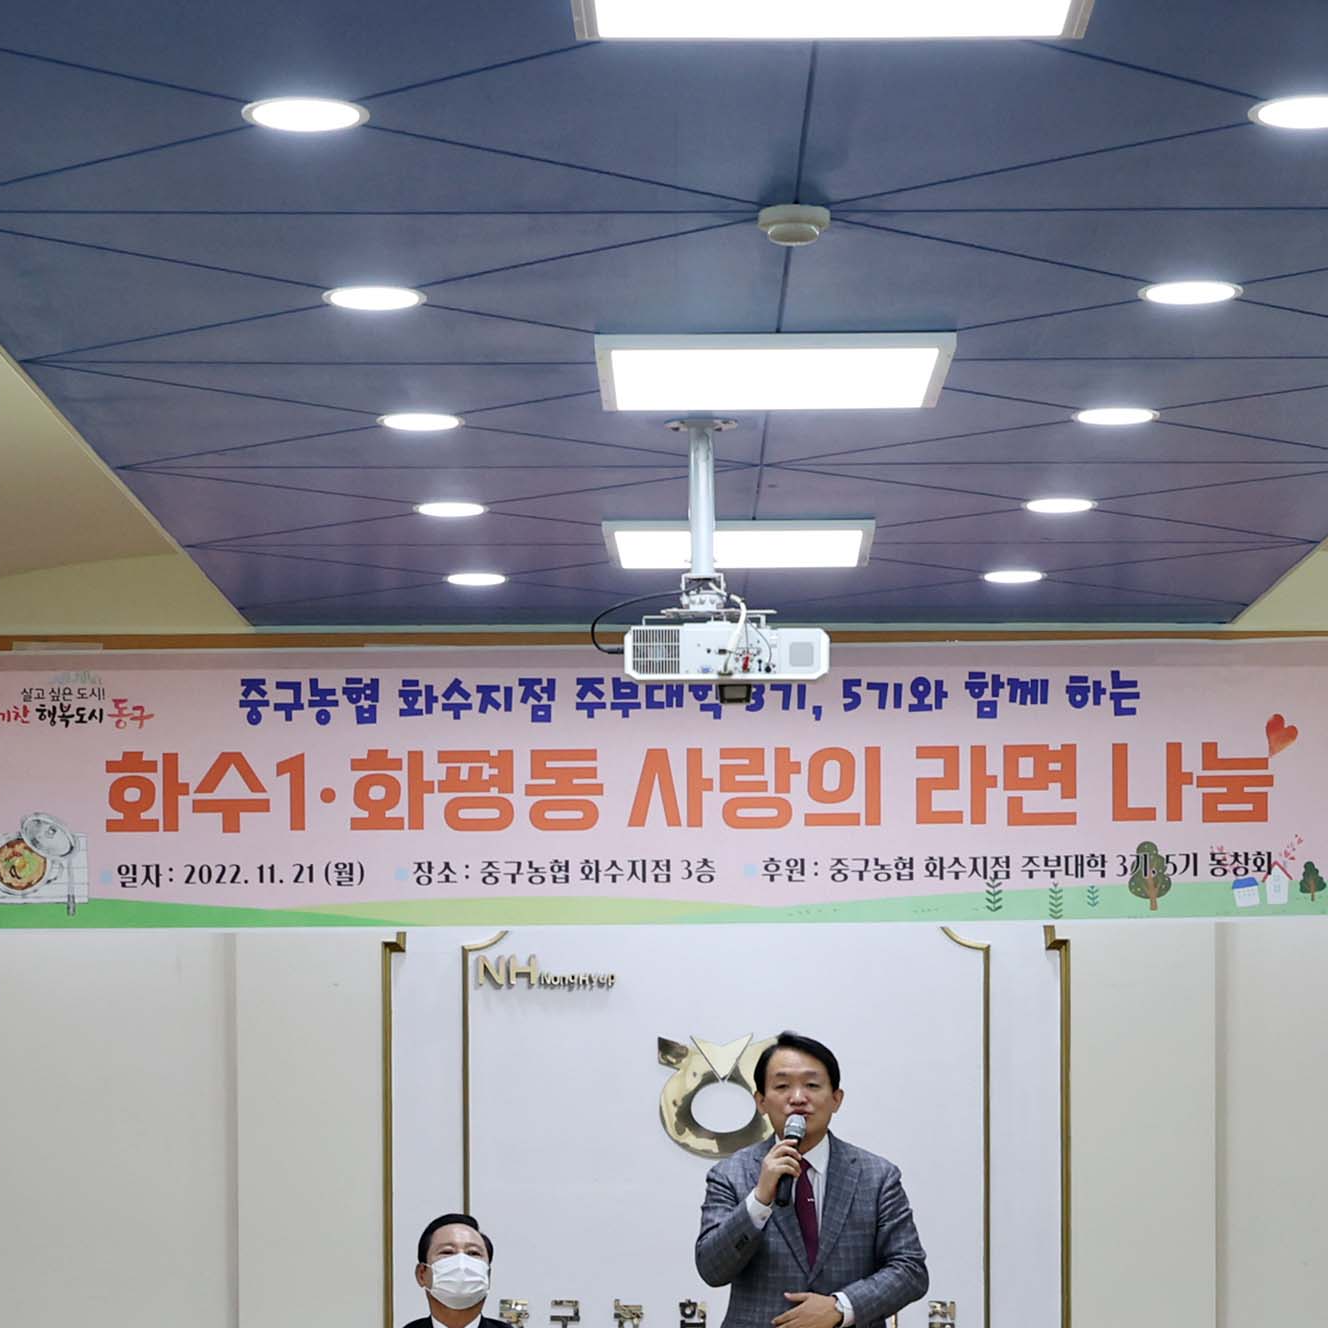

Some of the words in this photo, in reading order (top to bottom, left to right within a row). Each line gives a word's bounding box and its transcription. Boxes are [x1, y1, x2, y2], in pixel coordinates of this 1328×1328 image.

[21, 688, 45, 702] 살고
[49, 688, 73, 702] 싶은
[77, 688, 106, 701] 도시!
[239, 677, 380, 726] 중구농협
[399, 677, 557, 723] 화수지점
[842, 676, 949, 713] 5기와
[965, 671, 1050, 720] 함께
[1066, 671, 1141, 717] 하는
[35, 703, 104, 728] 행복도시
[108, 698, 154, 729] 동구
[627, 746, 881, 829] 사랑의
[916, 744, 1077, 826] 라면
[1113, 742, 1274, 823] 나눔
[293, 863, 315, 884] 21
[324, 861, 365, 887] (월)
[480, 859, 569, 886] 중구농협
[580, 858, 672, 884] 화수지점
[681, 857, 716, 884] 3층
[830, 856, 915, 883] 중구농협
[924, 855, 1011, 881] 화수지점
[1021, 853, 1107, 880] 주부대학
[1165, 852, 1199, 877] 5기
[1209, 851, 1273, 878] 동창회
[476, 954, 538, 988] NH
